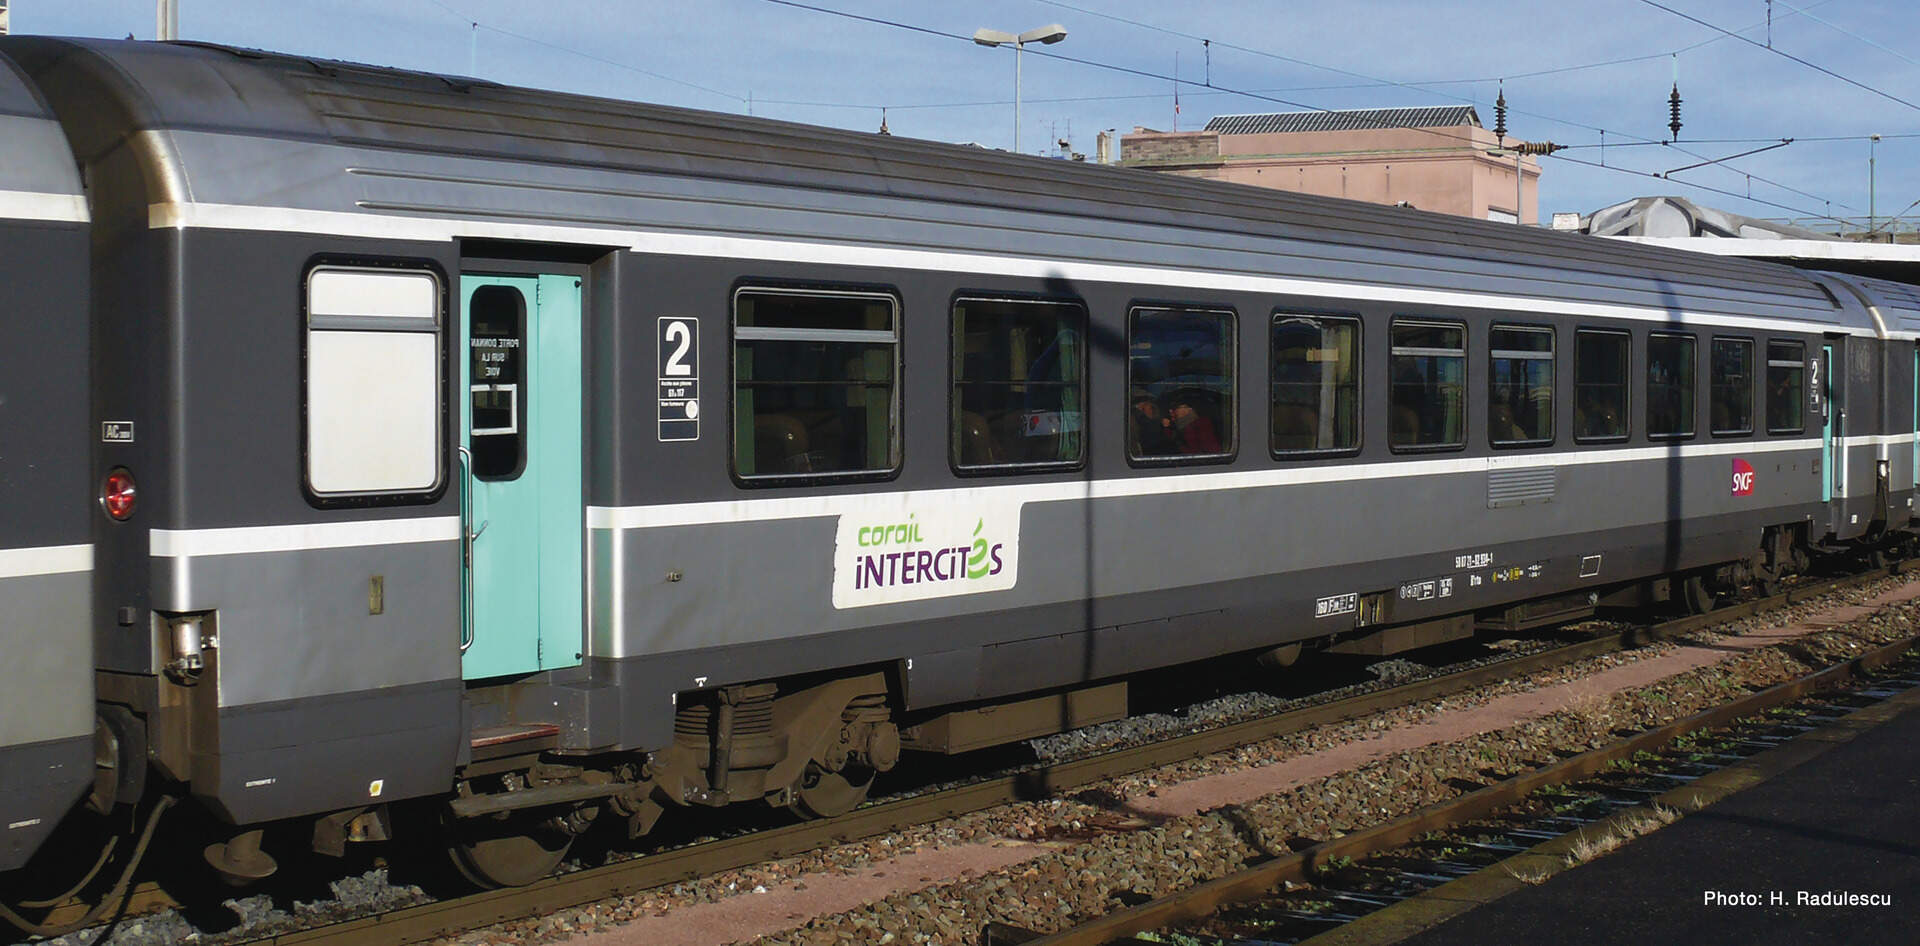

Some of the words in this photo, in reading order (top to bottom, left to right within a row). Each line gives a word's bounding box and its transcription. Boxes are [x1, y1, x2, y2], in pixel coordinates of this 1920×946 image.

[665, 321, 691, 376] 2
[1811, 360, 1818, 385] 2
[106, 424, 119, 439] AC
[1732, 472, 1753, 492] SNCF
[857, 512, 924, 547] corail
